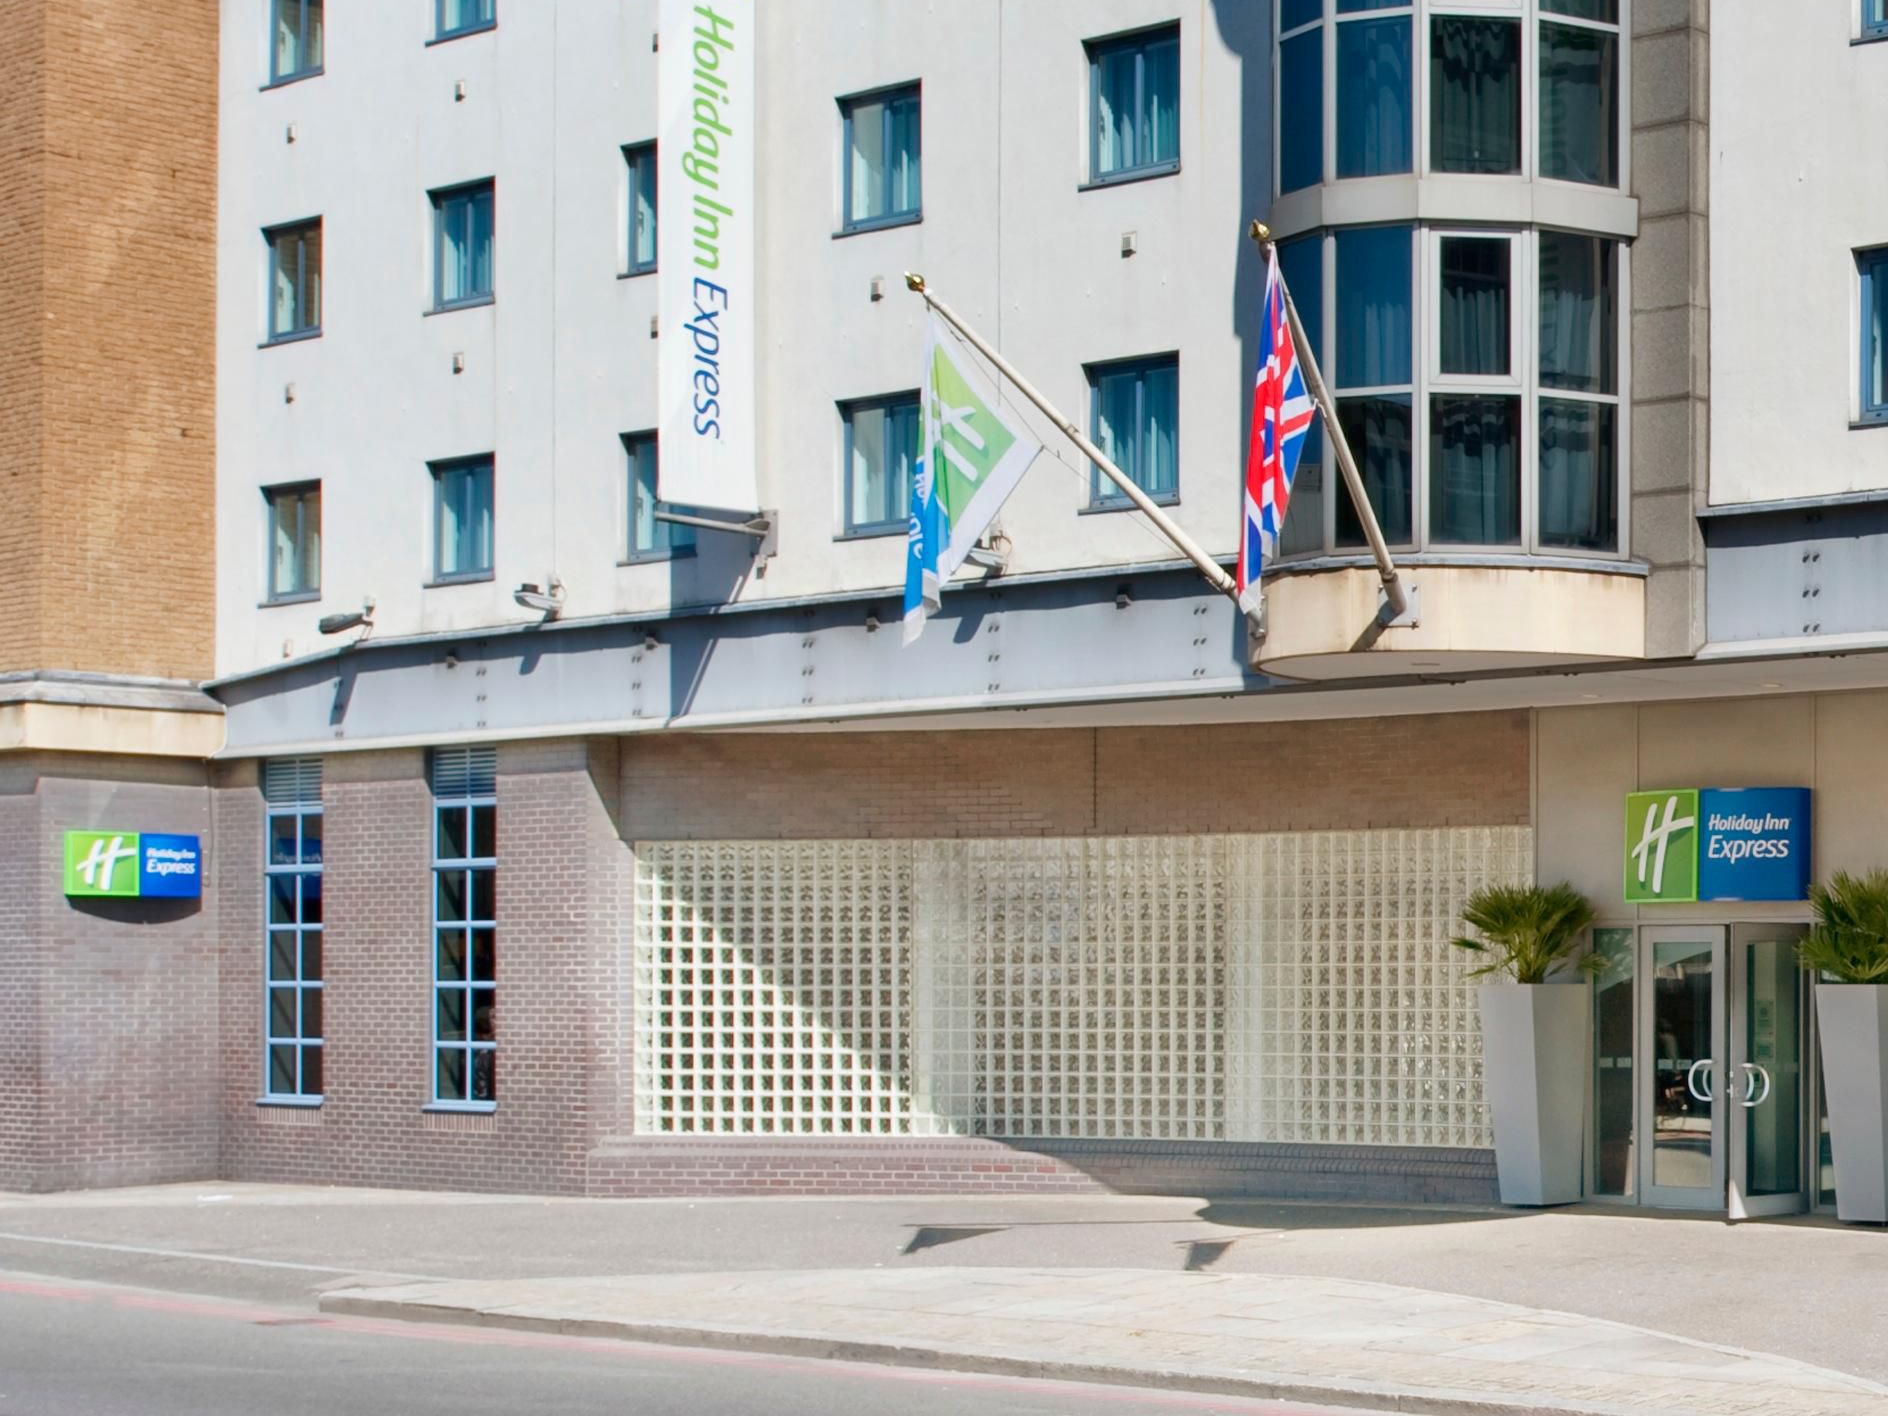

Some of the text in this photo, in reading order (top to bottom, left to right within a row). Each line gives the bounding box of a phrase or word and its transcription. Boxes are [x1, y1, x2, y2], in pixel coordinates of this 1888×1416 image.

[682, 5, 735, 440] Holiday Inn Express
[1708, 812, 1790, 835] Holiday Inn
[1708, 835, 1790, 864] Express
[146, 858, 196, 876] Express
